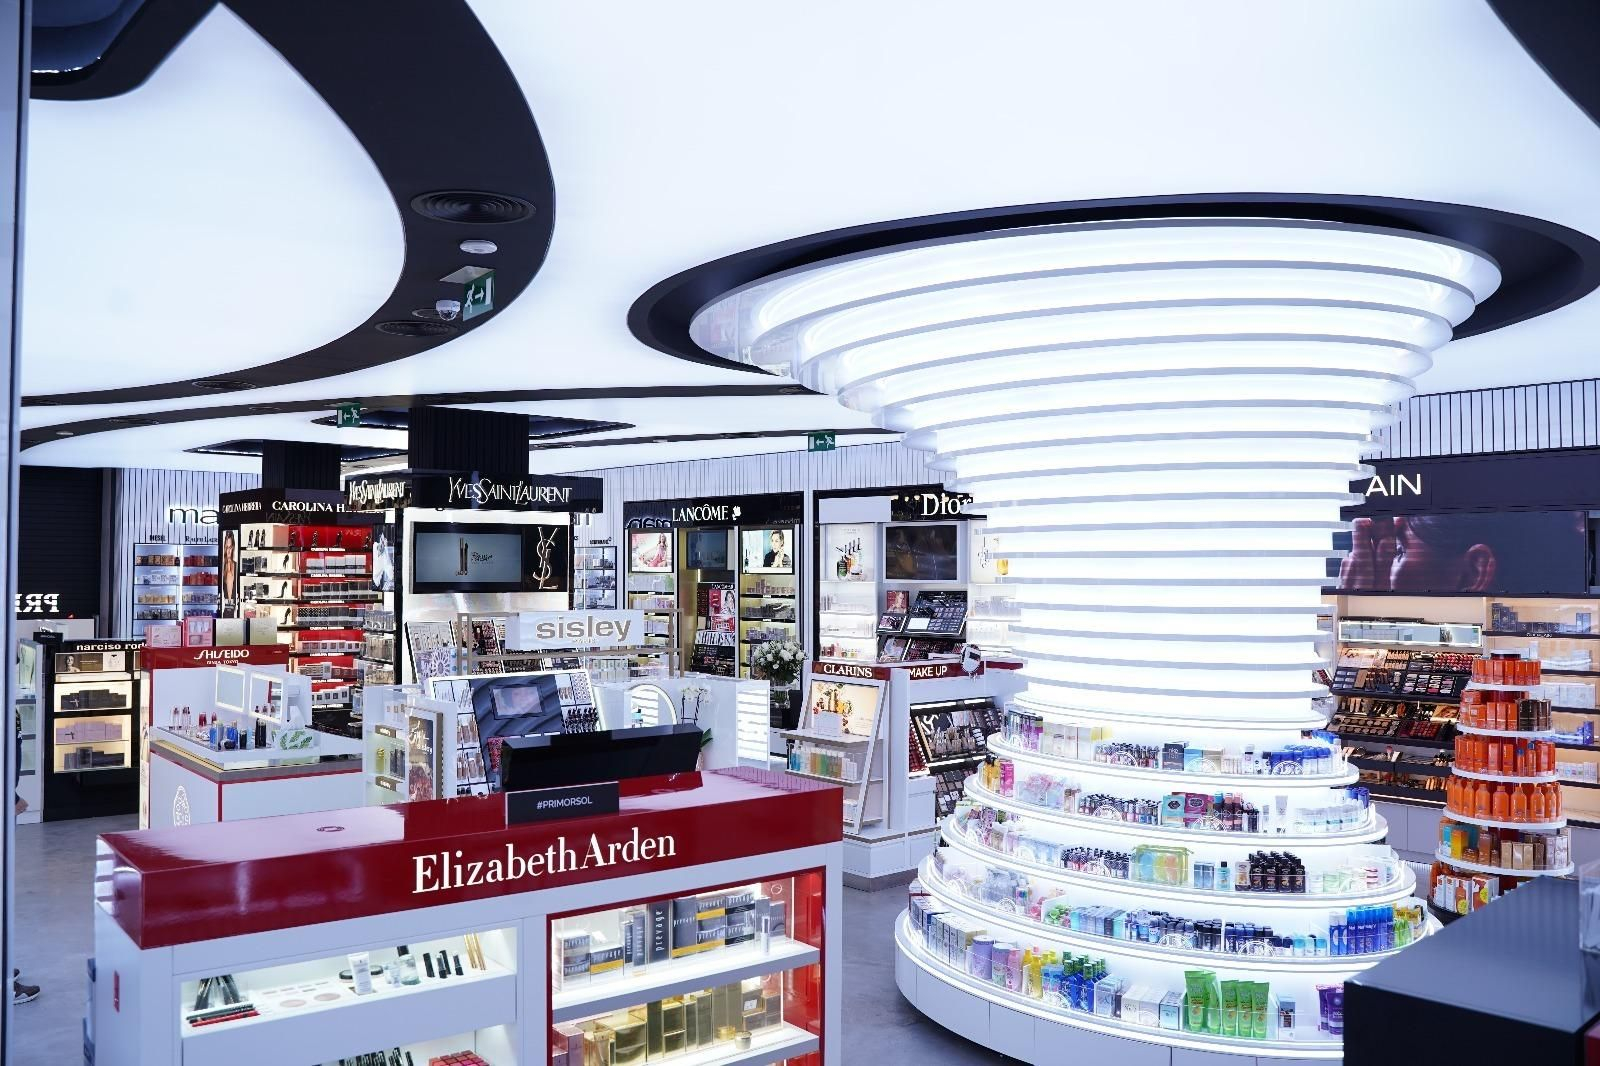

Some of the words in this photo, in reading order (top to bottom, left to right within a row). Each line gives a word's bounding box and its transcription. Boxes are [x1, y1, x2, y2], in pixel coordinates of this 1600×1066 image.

[272, 501, 333, 513] CAROLINA
[672, 504, 729, 522] LANCÔME
[536, 615, 632, 642] sisley
[76, 642, 121, 651] narciso
[194, 649, 250, 660] SHISEIDO
[823, 664, 873, 678] CLARINS
[909, 667, 933, 678] MAKE
[935, 665, 948, 676] UP
[536, 795, 593, 810] #PRIMORSOL
[655, 908, 665, 953] prevage
